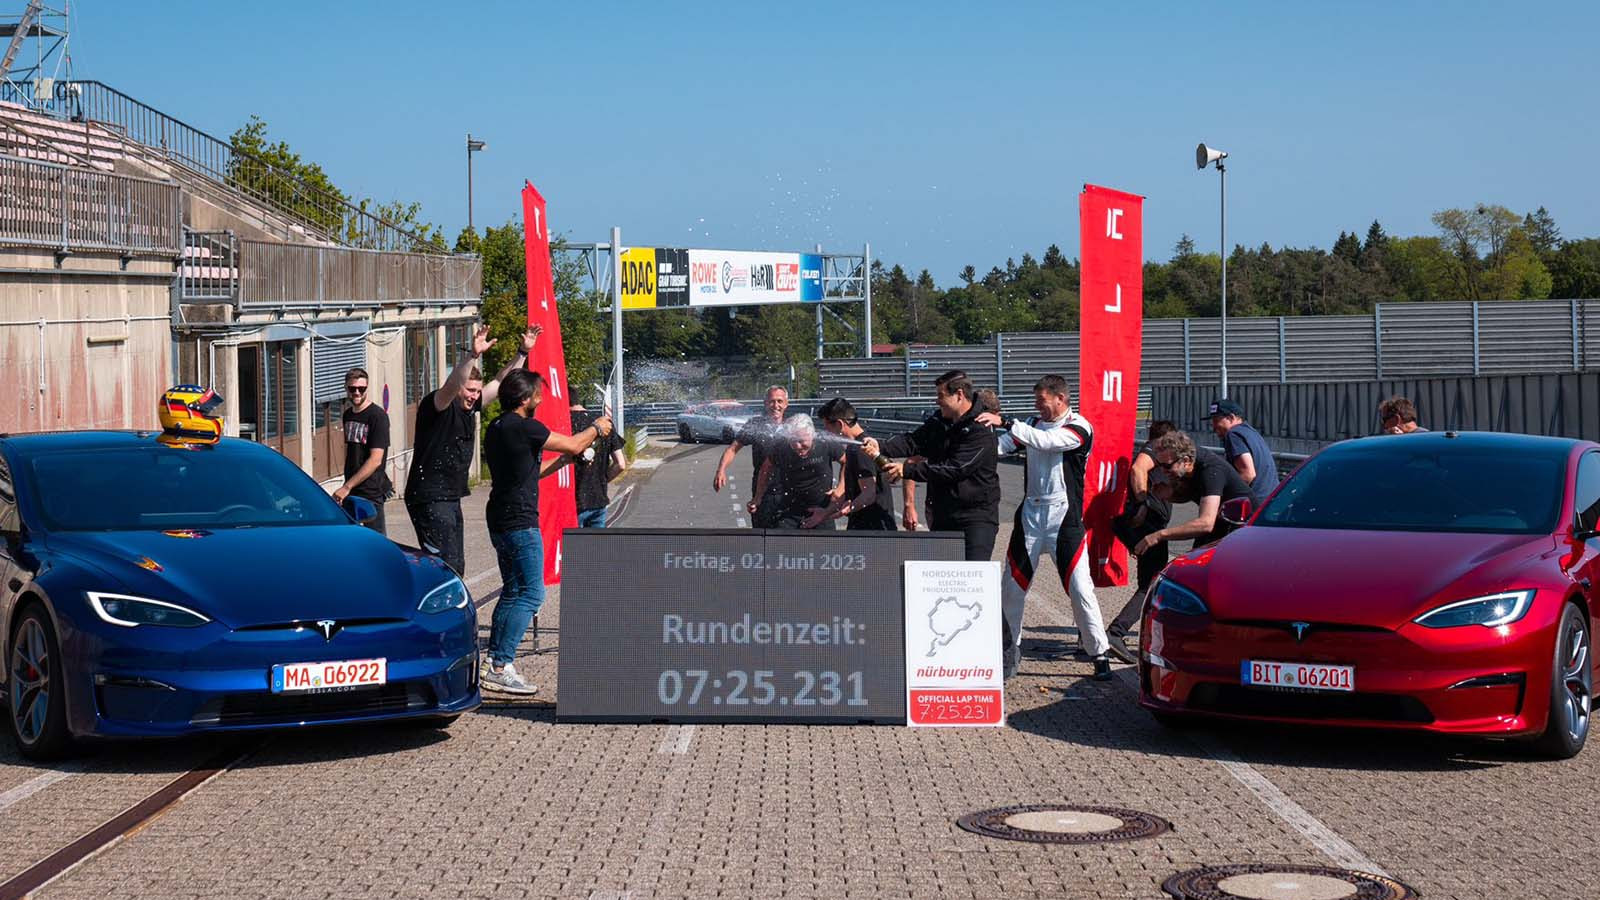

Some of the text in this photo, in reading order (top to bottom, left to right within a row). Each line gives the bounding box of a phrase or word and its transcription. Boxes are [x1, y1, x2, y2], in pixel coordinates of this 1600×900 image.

[621, 261, 653, 295] ADAC
[692, 262, 717, 284] ROWE
[664, 551, 866, 572] Freitag, 02. Juni 2023
[922, 570, 984, 578] NORDSCHLEIFE
[662, 613, 865, 645] Rundenzeit:
[285, 662, 379, 687] MA 06922
[916, 666, 993, 680] nürburgring
[1253, 663, 1350, 688] BIT 06201
[657, 670, 868, 706] 07:25.231
[917, 695, 994, 703] OFFICIAL LAP TIME
[919, 703, 990, 720] 7:25.231
